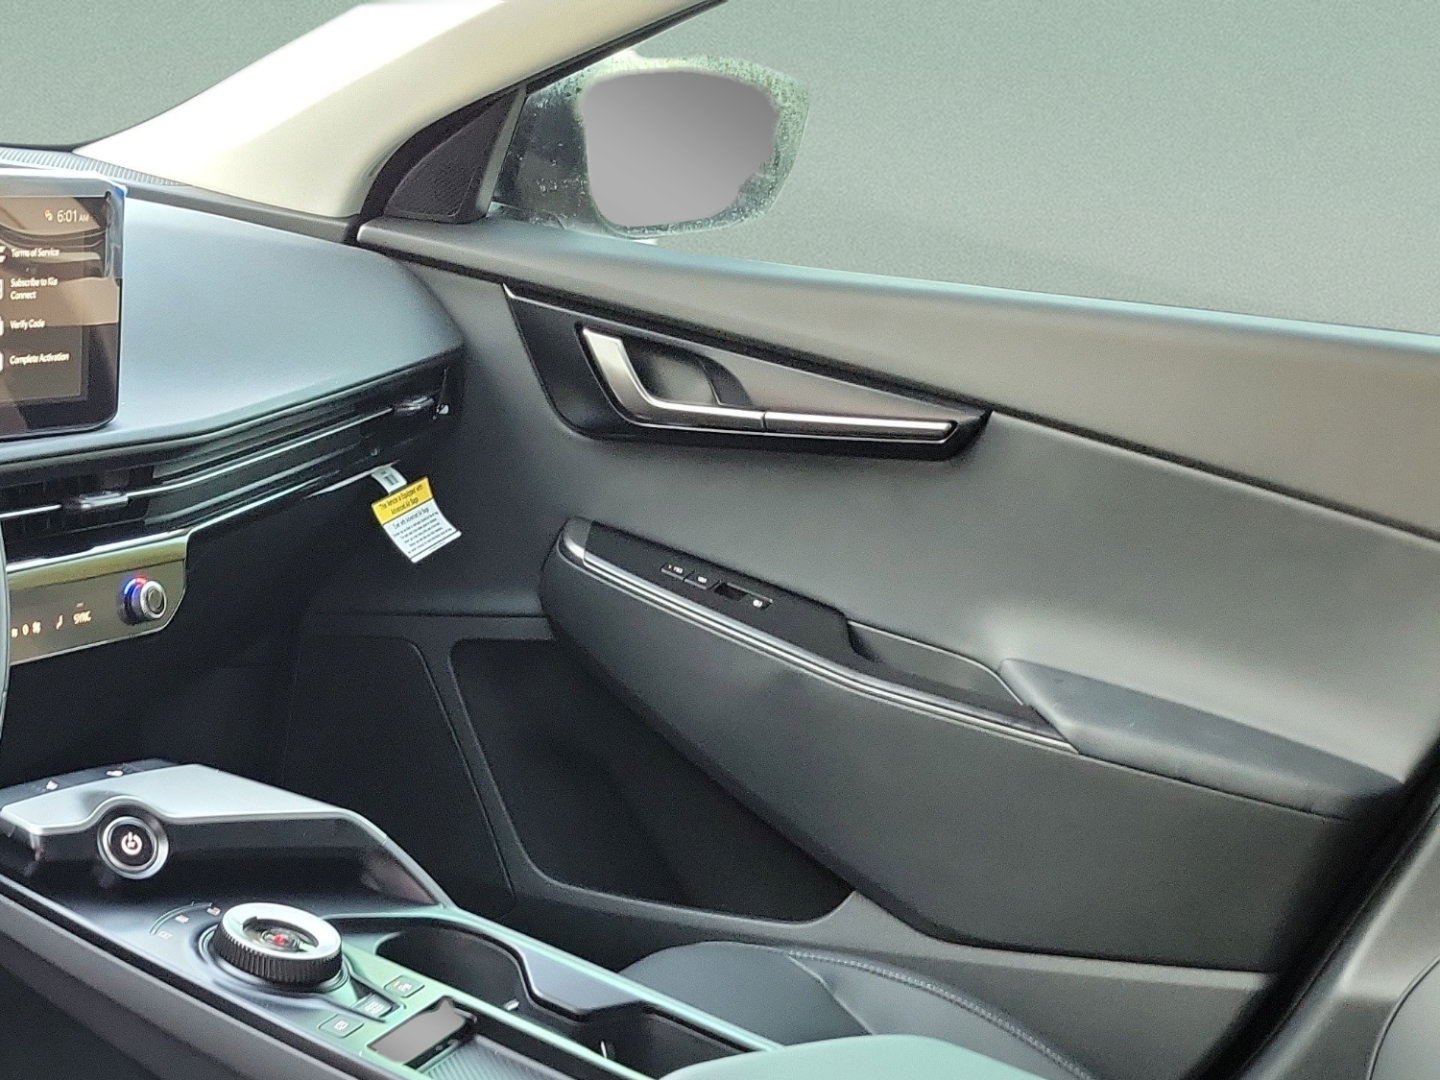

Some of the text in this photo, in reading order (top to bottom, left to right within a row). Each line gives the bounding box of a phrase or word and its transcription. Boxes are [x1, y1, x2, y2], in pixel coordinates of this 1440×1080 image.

[56, 210, 90, 222] 6:01 AM
[11, 248, 30, 257] Terms
[38, 248, 60, 257] Service
[10, 277, 58, 287] Subscribe to Kia
[10, 290, 37, 300] Connect
[10, 318, 46, 330] Verify Code
[10, 351, 71, 365] Complete Activation
